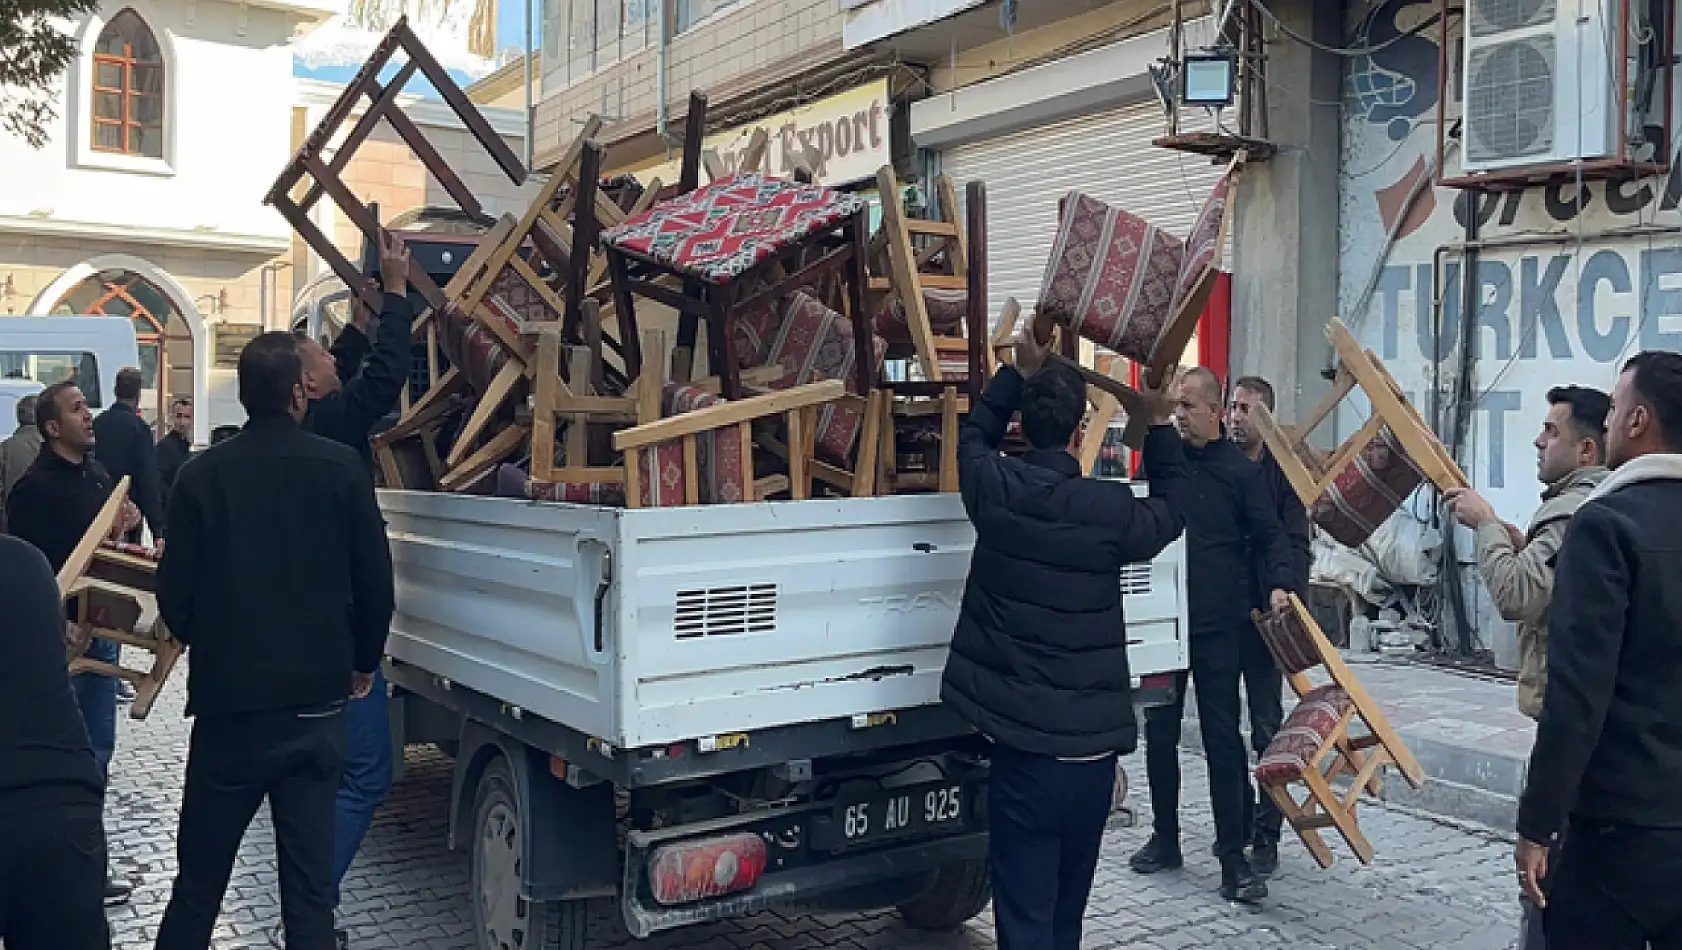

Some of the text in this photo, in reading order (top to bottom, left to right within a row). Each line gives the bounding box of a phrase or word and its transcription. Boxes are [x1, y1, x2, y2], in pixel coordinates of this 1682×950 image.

[845, 786, 960, 838] 65 AU 925
